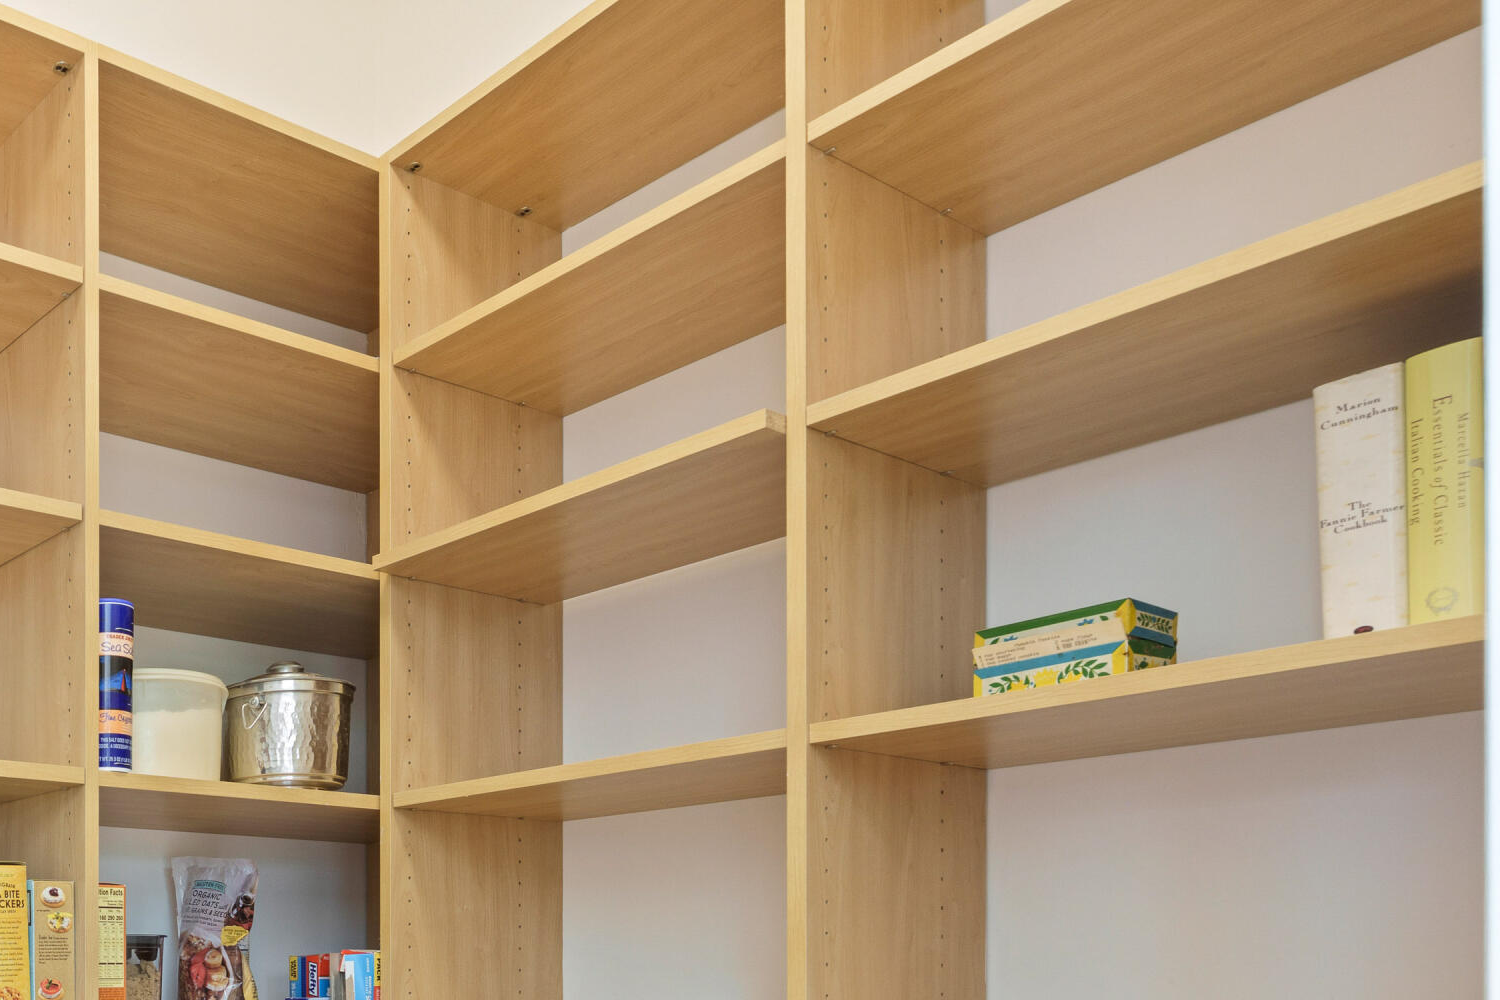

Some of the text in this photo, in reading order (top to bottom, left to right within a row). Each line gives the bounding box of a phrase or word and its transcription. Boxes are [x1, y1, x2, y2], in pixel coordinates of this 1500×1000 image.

[1336, 397, 1381, 414] Marion
[1320, 405, 1399, 431] Cunningham
[1457, 412, 1471, 509] Marcella Hazan
[1410, 418, 1425, 525] Italian Cooking
[1429, 394, 1453, 546] Essentials of Classic
[1348, 500, 1372, 511] The
[1320, 504, 1405, 529] Fannie Farmer
[1333, 516, 1388, 534] Cookbook
[101, 641, 122, 653] Sea
[5, 890, 20, 899] BITE
[192, 890, 222, 900] ORGANIC
[202, 900, 219, 909] OATS
[309, 963, 317, 996] Hefty
